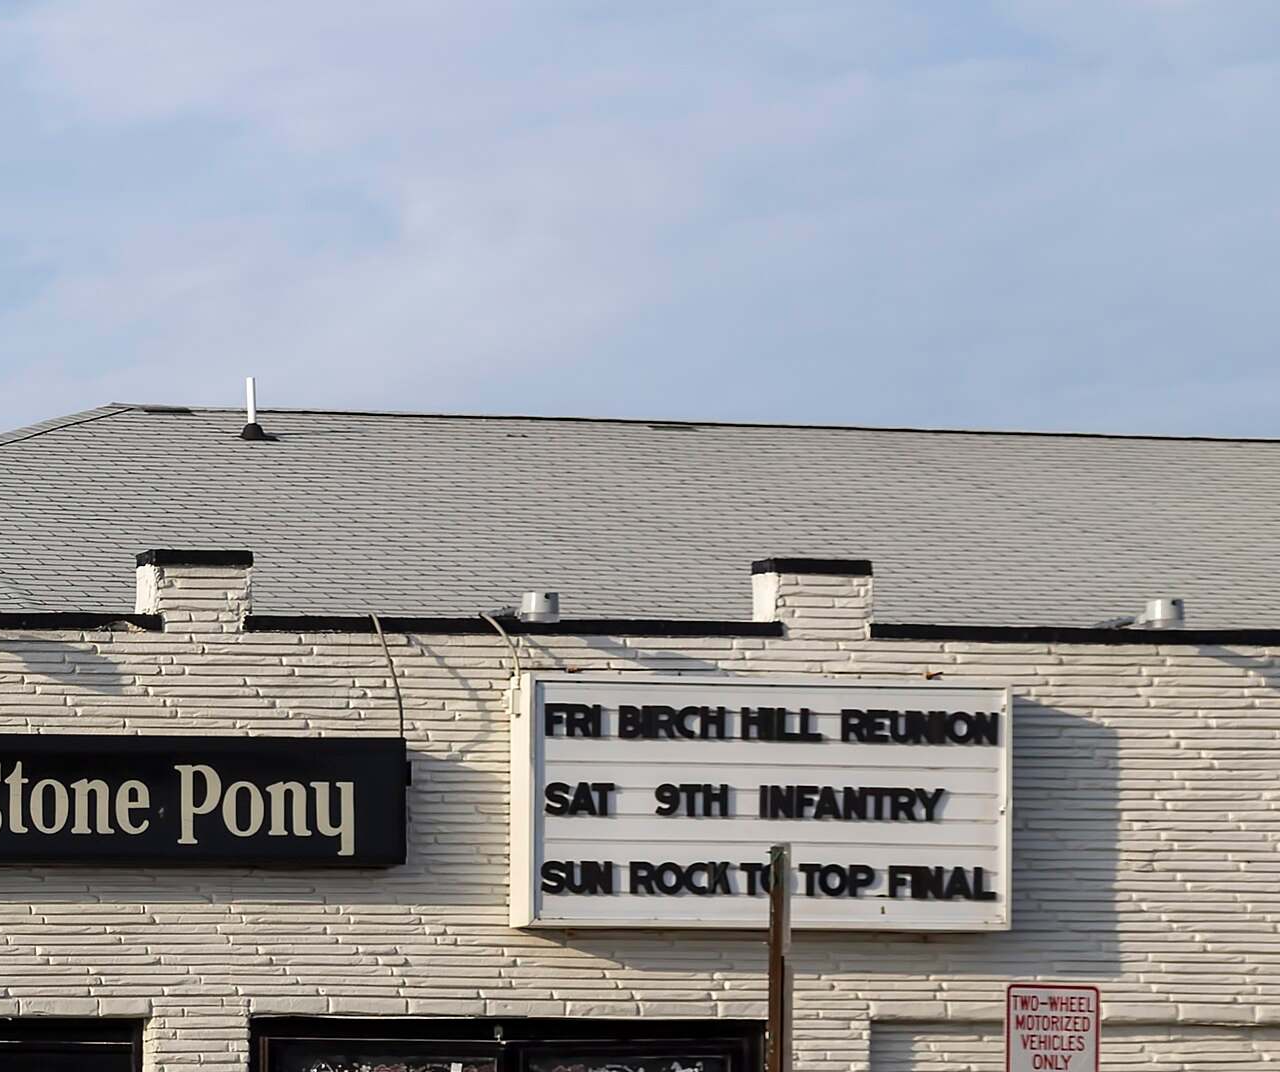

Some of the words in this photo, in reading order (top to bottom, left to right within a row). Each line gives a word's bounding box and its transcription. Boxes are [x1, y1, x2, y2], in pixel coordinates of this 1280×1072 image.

[544, 702, 602, 738] FRI
[618, 704, 726, 741] BIRCH
[741, 706, 823, 743] HILL
[841, 708, 1000, 747] REUNION
[173, 763, 355, 857] Pony
[544, 781, 615, 817] SAT
[655, 782, 730, 818] 9TH
[759, 784, 946, 822] INFANTRY
[540, 860, 614, 896] SUN
[629, 861, 730, 898] ROCK
[798, 862, 875, 898] TOP
[888, 864, 997, 901] FINAL
[1012, 994, 1095, 1013] TWO-WHEEL
[1015, 1014, 1090, 1032] MOTORIZED
[1021, 1034, 1085, 1051] VEHICLES
[1032, 1054, 1072, 1071] ONLY
